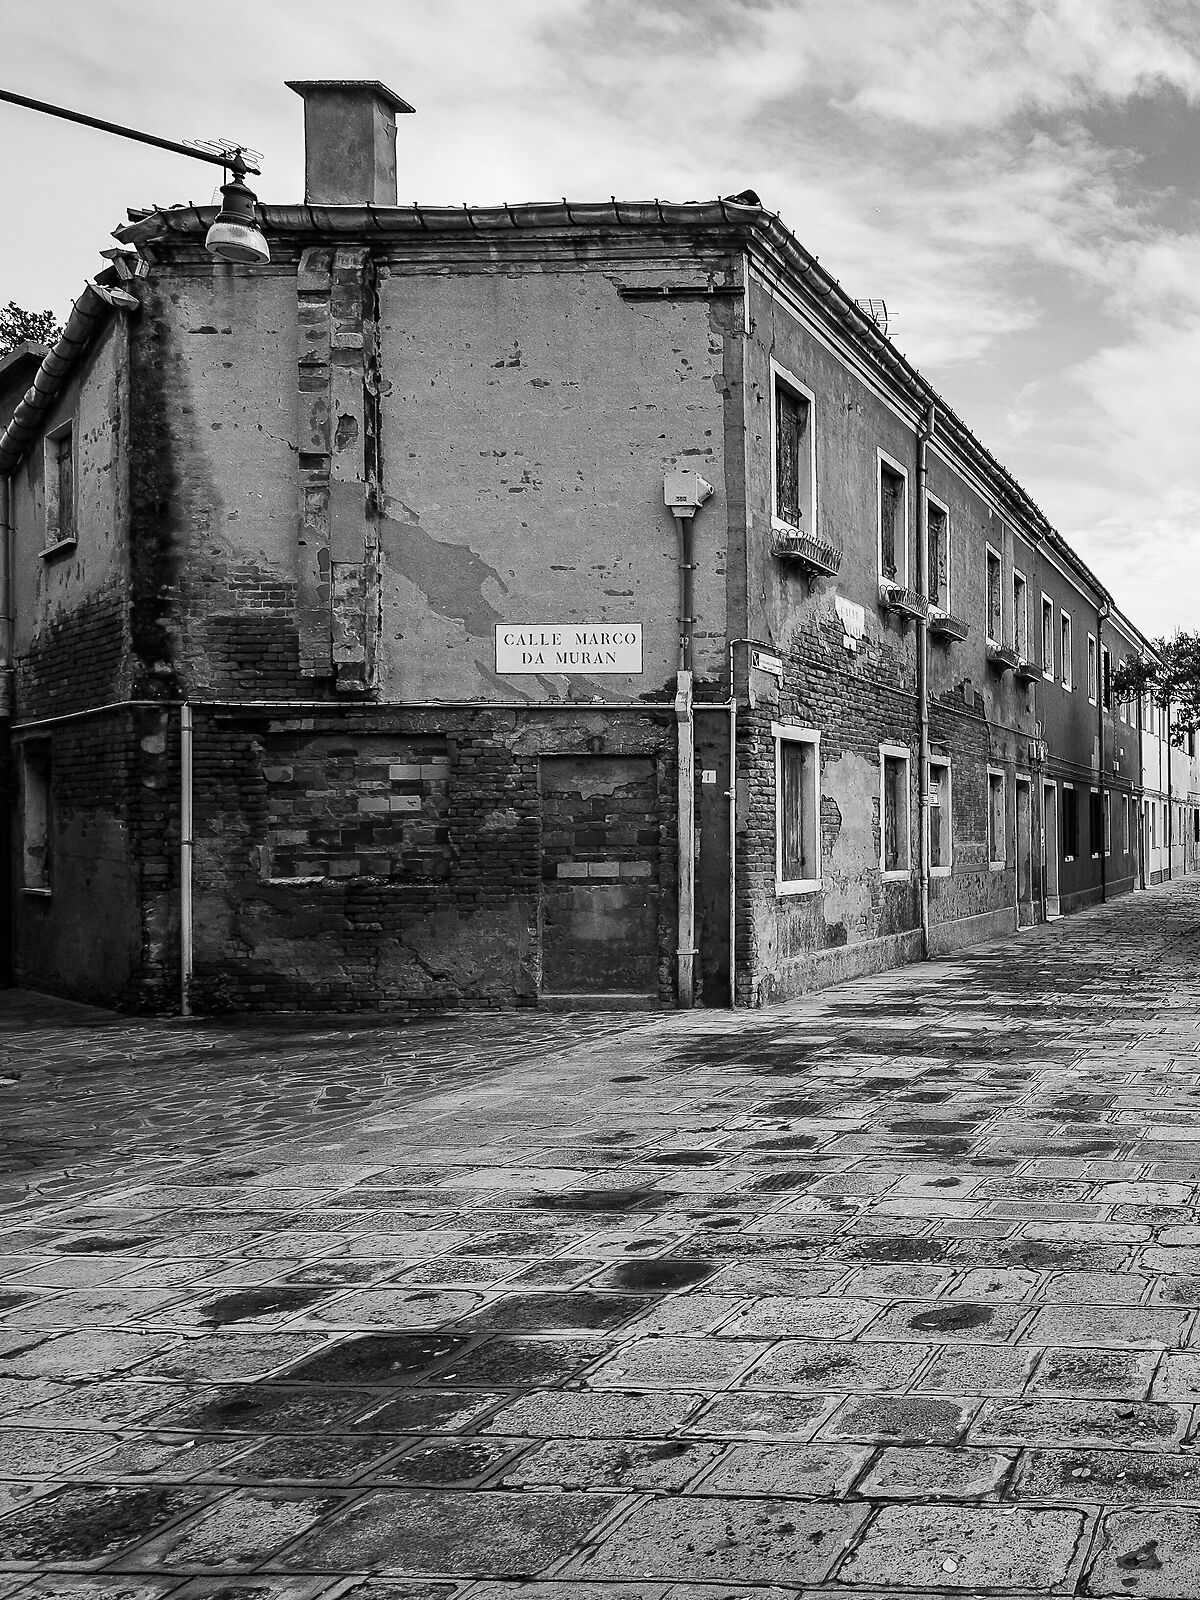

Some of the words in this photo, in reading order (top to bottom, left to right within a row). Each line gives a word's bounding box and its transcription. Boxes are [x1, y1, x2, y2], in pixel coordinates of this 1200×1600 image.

[504, 632, 562, 646] CALLE
[575, 632, 636, 646] MARCO
[522, 652, 545, 665] DA
[555, 652, 617, 665] MURAN
